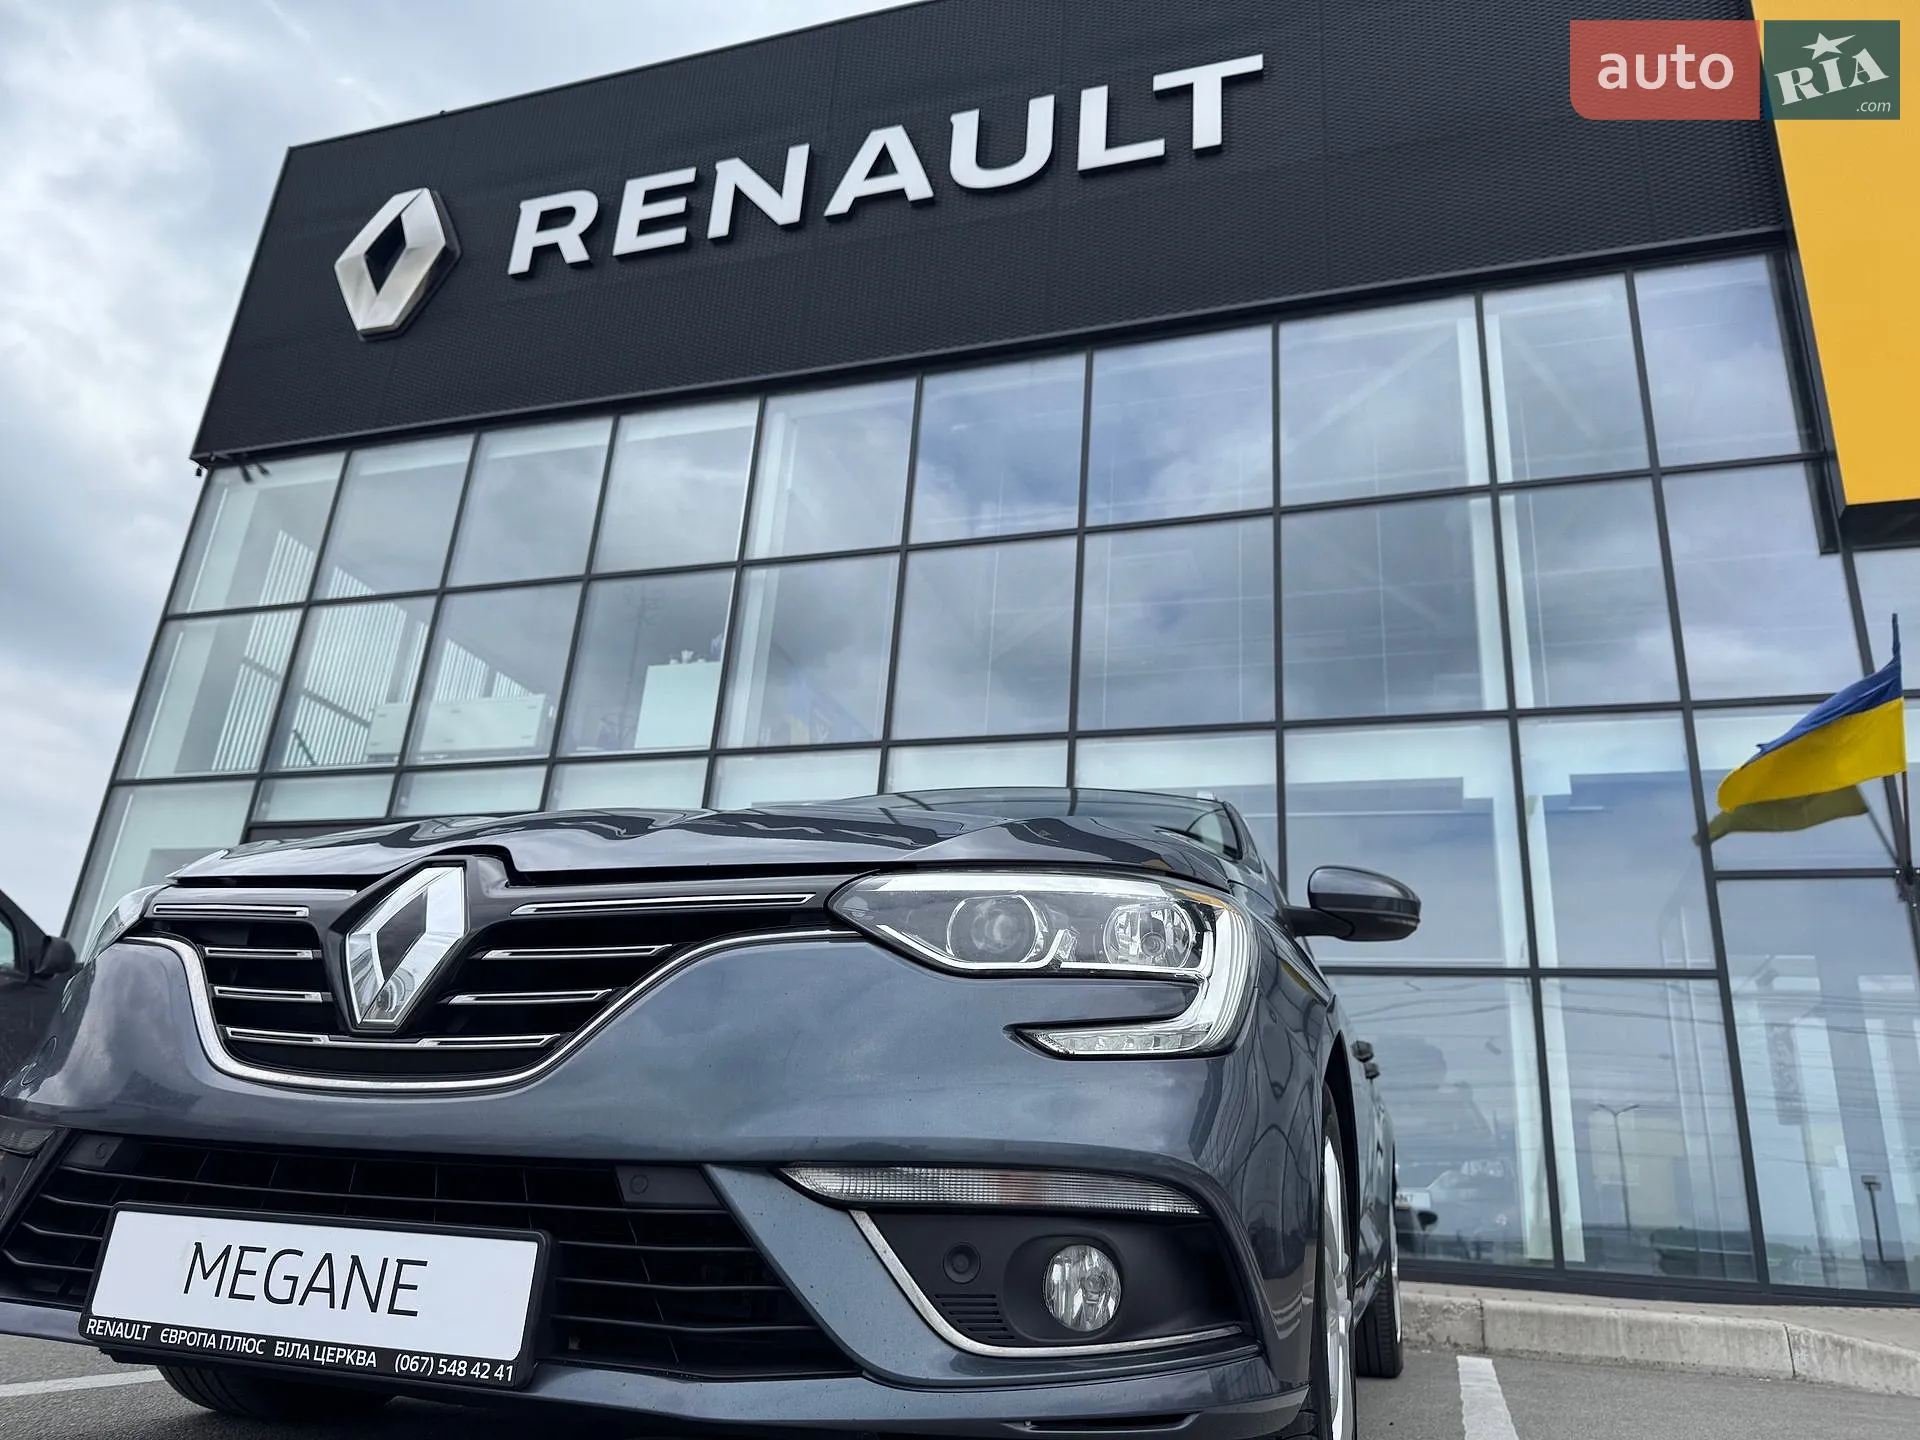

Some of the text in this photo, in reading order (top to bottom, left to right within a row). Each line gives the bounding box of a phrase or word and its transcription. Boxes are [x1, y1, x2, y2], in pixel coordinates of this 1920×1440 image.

[507, 54, 1264, 276] RENAULT
[183, 1241, 428, 1317] MEGANE
[85, 1318, 514, 1382] RENAULT ЄВРОПА ПЛЮС БІЛА ЦЕРКВА (067) 548 42 41
